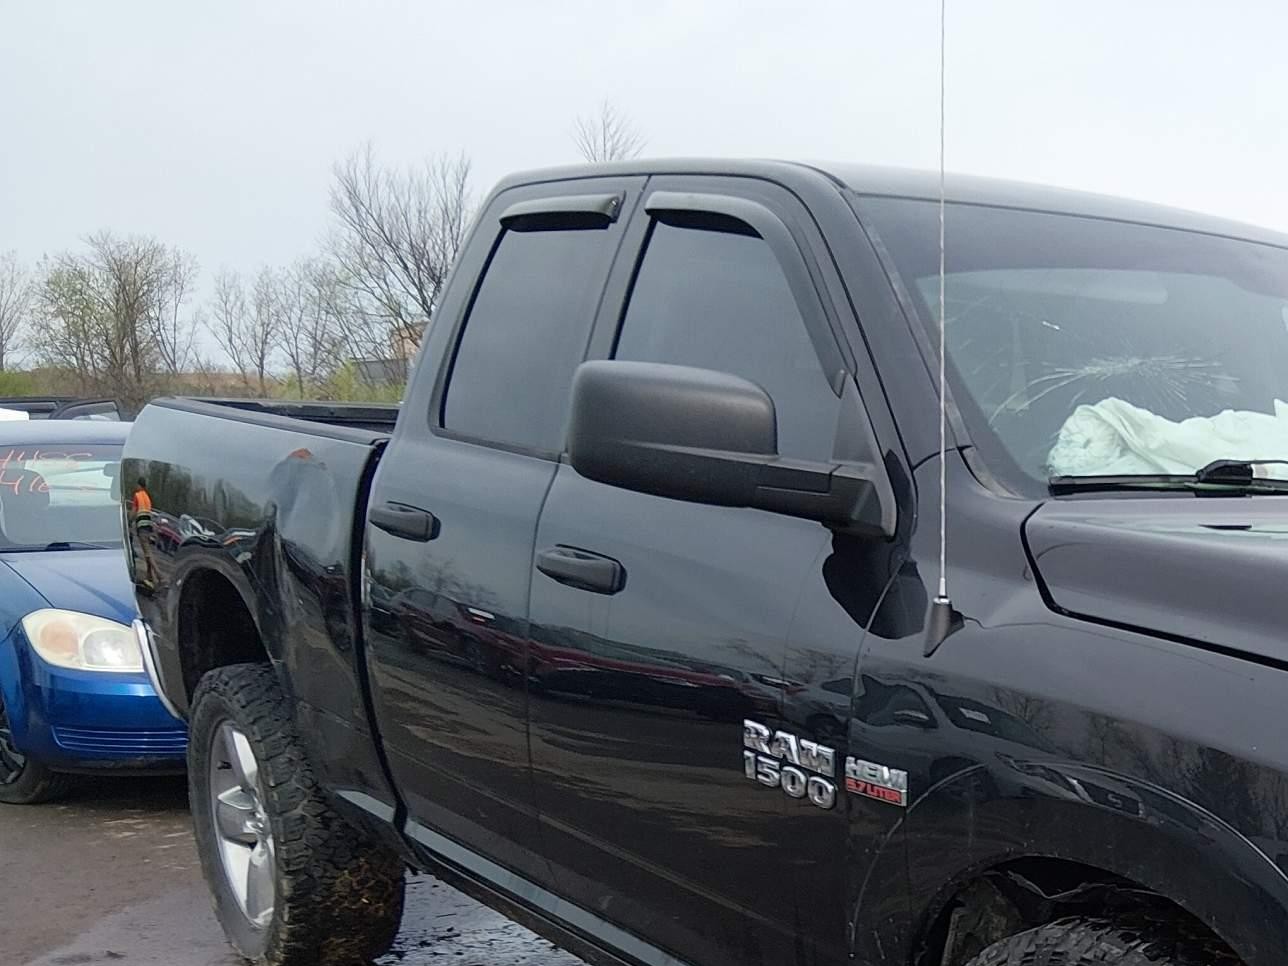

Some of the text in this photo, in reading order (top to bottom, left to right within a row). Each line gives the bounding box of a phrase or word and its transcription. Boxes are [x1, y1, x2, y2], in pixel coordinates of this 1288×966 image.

[743, 719, 836, 778] RAM
[743, 750, 836, 809] 1500
[845, 756, 908, 788] HEMI
[846, 778, 901, 803] 5.7 LITER
